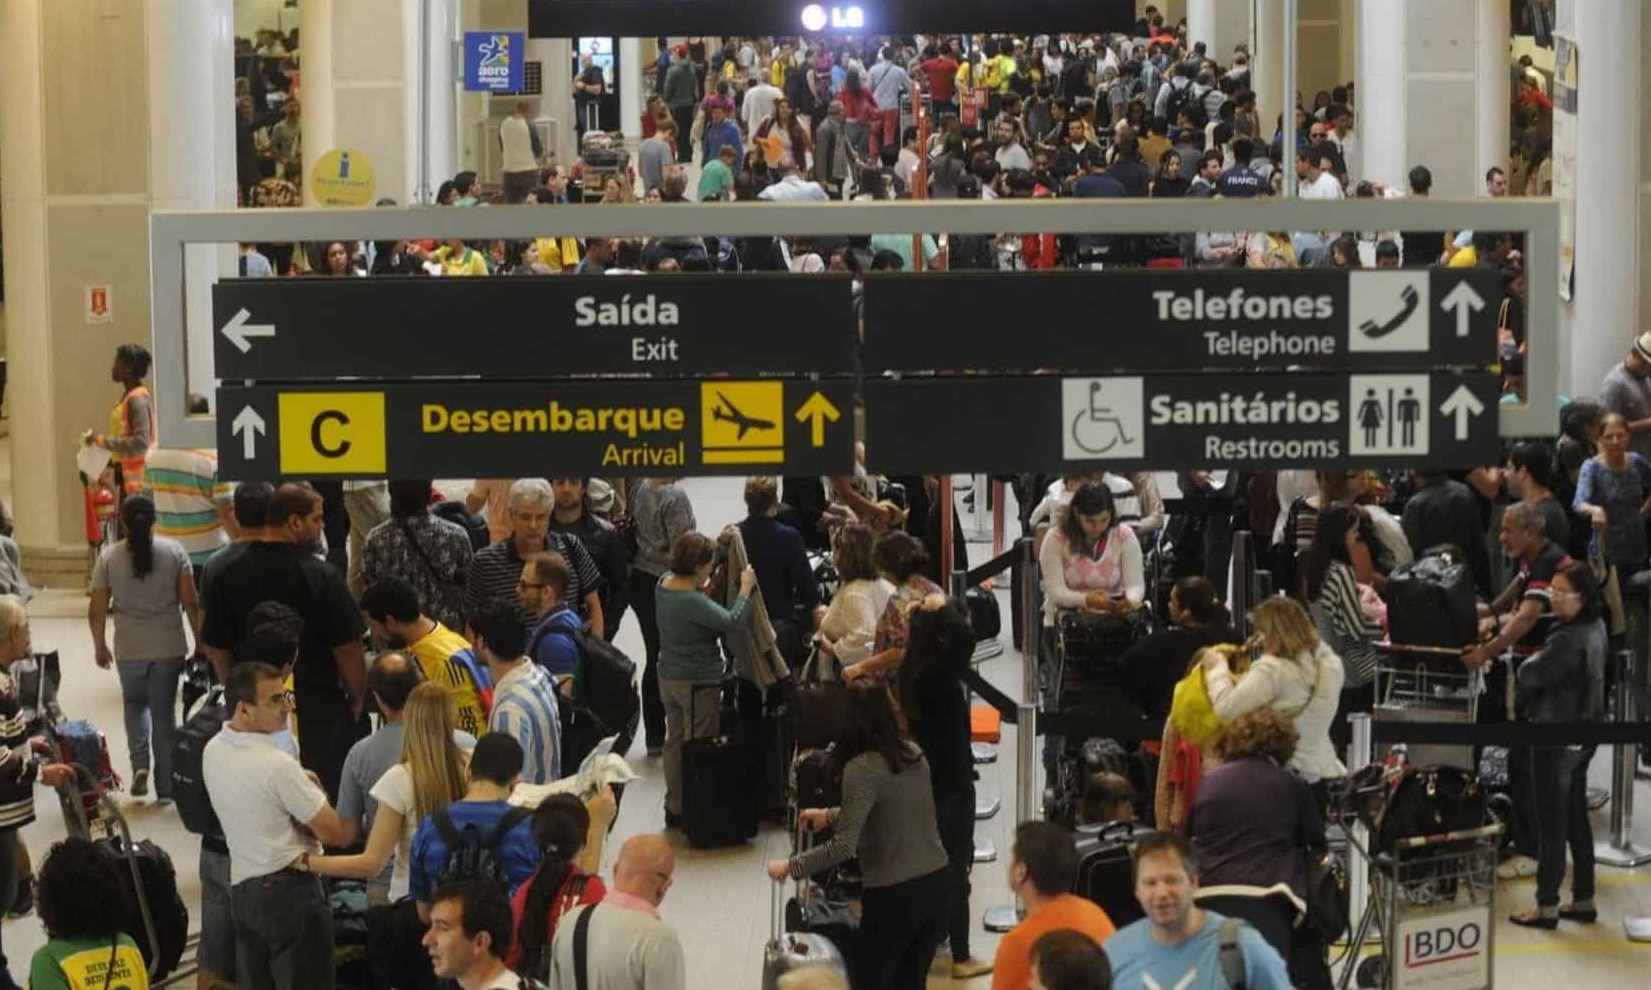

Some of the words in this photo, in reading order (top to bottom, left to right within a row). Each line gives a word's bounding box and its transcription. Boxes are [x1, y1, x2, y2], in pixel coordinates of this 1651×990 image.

[478, 66, 509, 76] aero
[575, 294, 679, 326] Saída
[1153, 288, 1333, 320] Telefones
[631, 337, 679, 362] Exit
[1204, 331, 1335, 360] Telephone
[421, 401, 686, 438] Desembarque
[1150, 392, 1340, 426] Sanitários
[310, 409, 352, 459] C
[1205, 435, 1339, 460] Restrooms
[601, 442, 685, 467] Arrival
[1415, 922, 1481, 959] BDO
